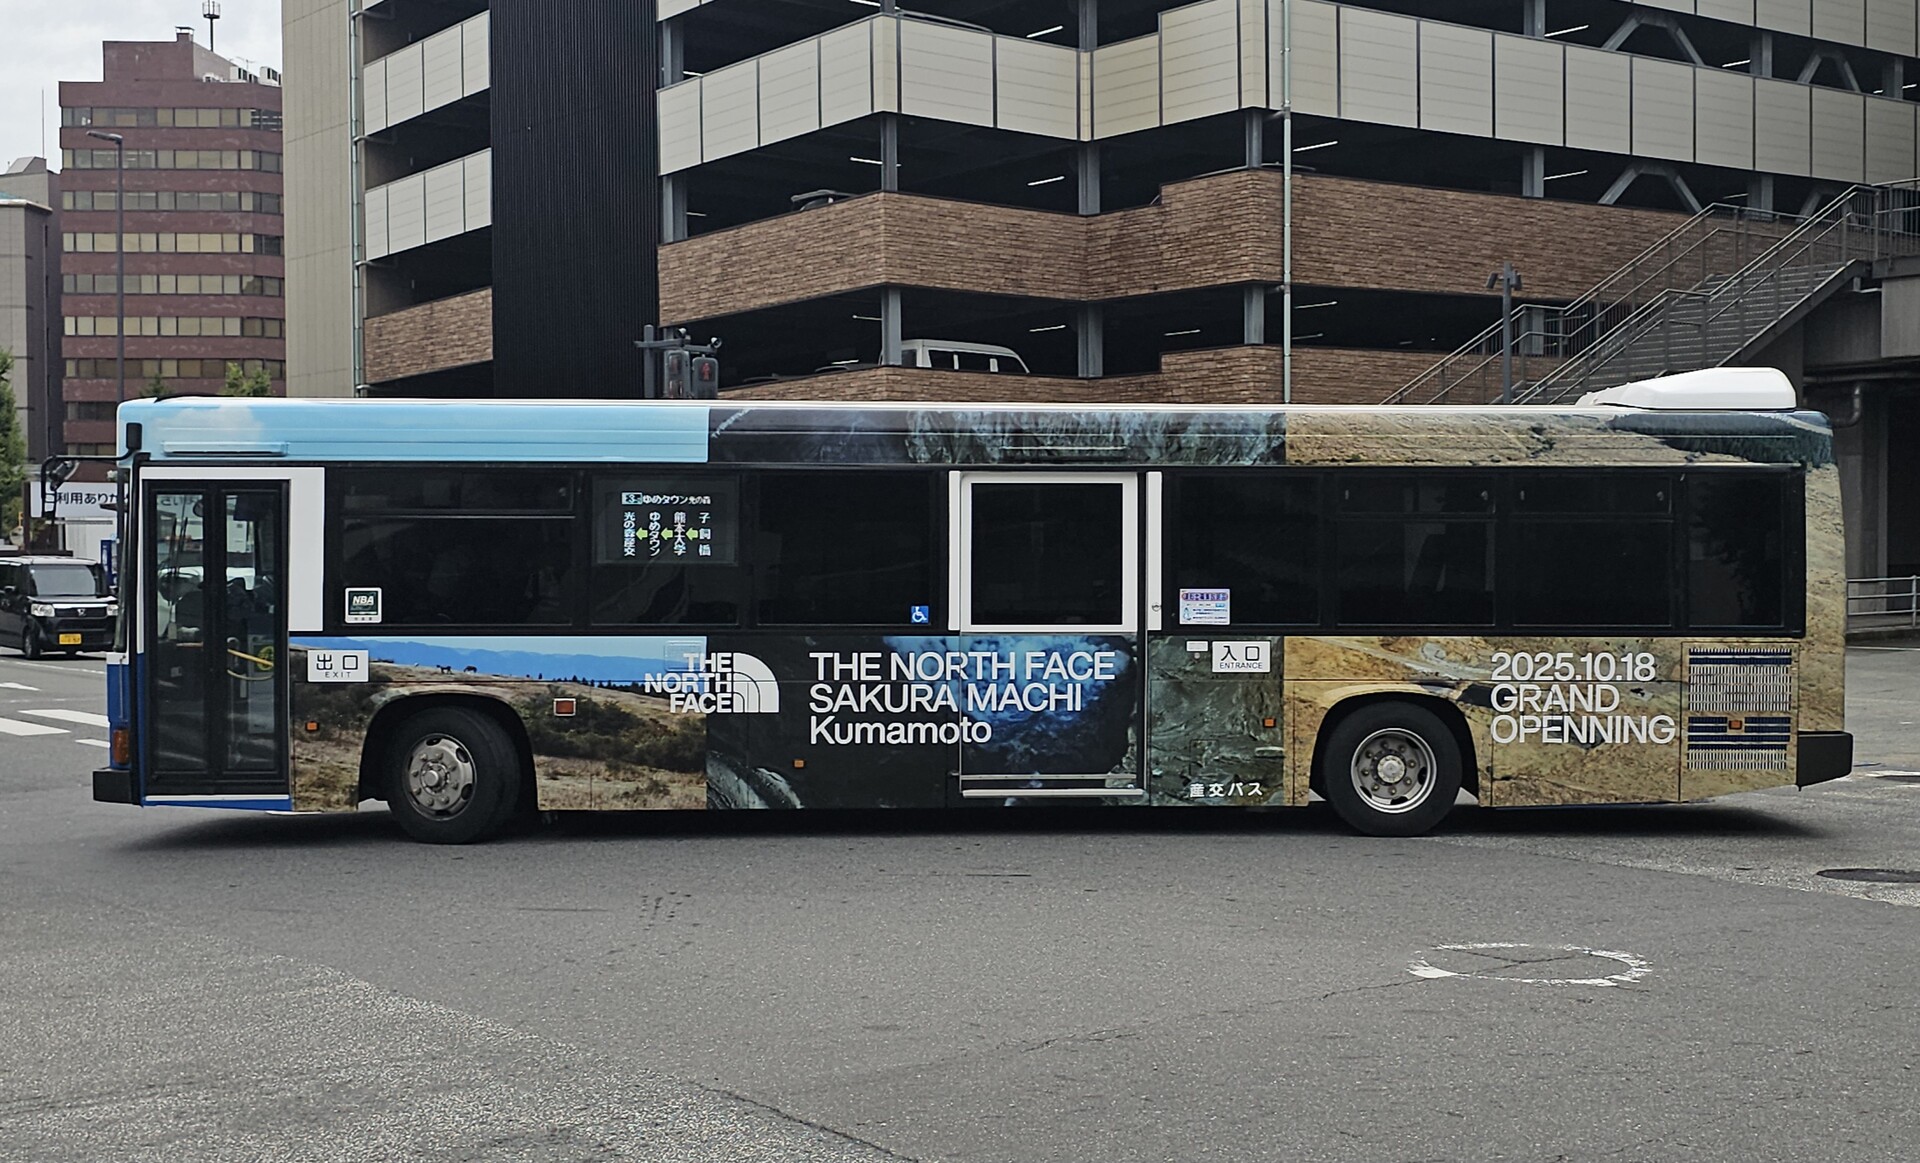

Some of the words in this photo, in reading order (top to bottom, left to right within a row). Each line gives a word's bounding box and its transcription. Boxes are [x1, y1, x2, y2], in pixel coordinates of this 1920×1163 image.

[352, 595, 374, 606] NBA
[316, 653, 358, 670] 出口
[683, 652, 732, 672] THE
[1220, 645, 1260, 661] 入口
[809, 652, 882, 681] THE
[890, 651, 1015, 681] NORTH
[1025, 651, 1115, 680] FACE
[1490, 652, 1656, 681] 2025.10.18
[644, 672, 732, 693] NORTH
[669, 692, 732, 714] FACE
[809, 683, 958, 713] SAKURA
[967, 683, 1081, 711] MACHI
[1490, 684, 1620, 713] GRAND
[810, 715, 992, 745] Kumamoto
[1490, 715, 1676, 744] OPENNING
[1190, 782, 1263, 798] 産交バス
